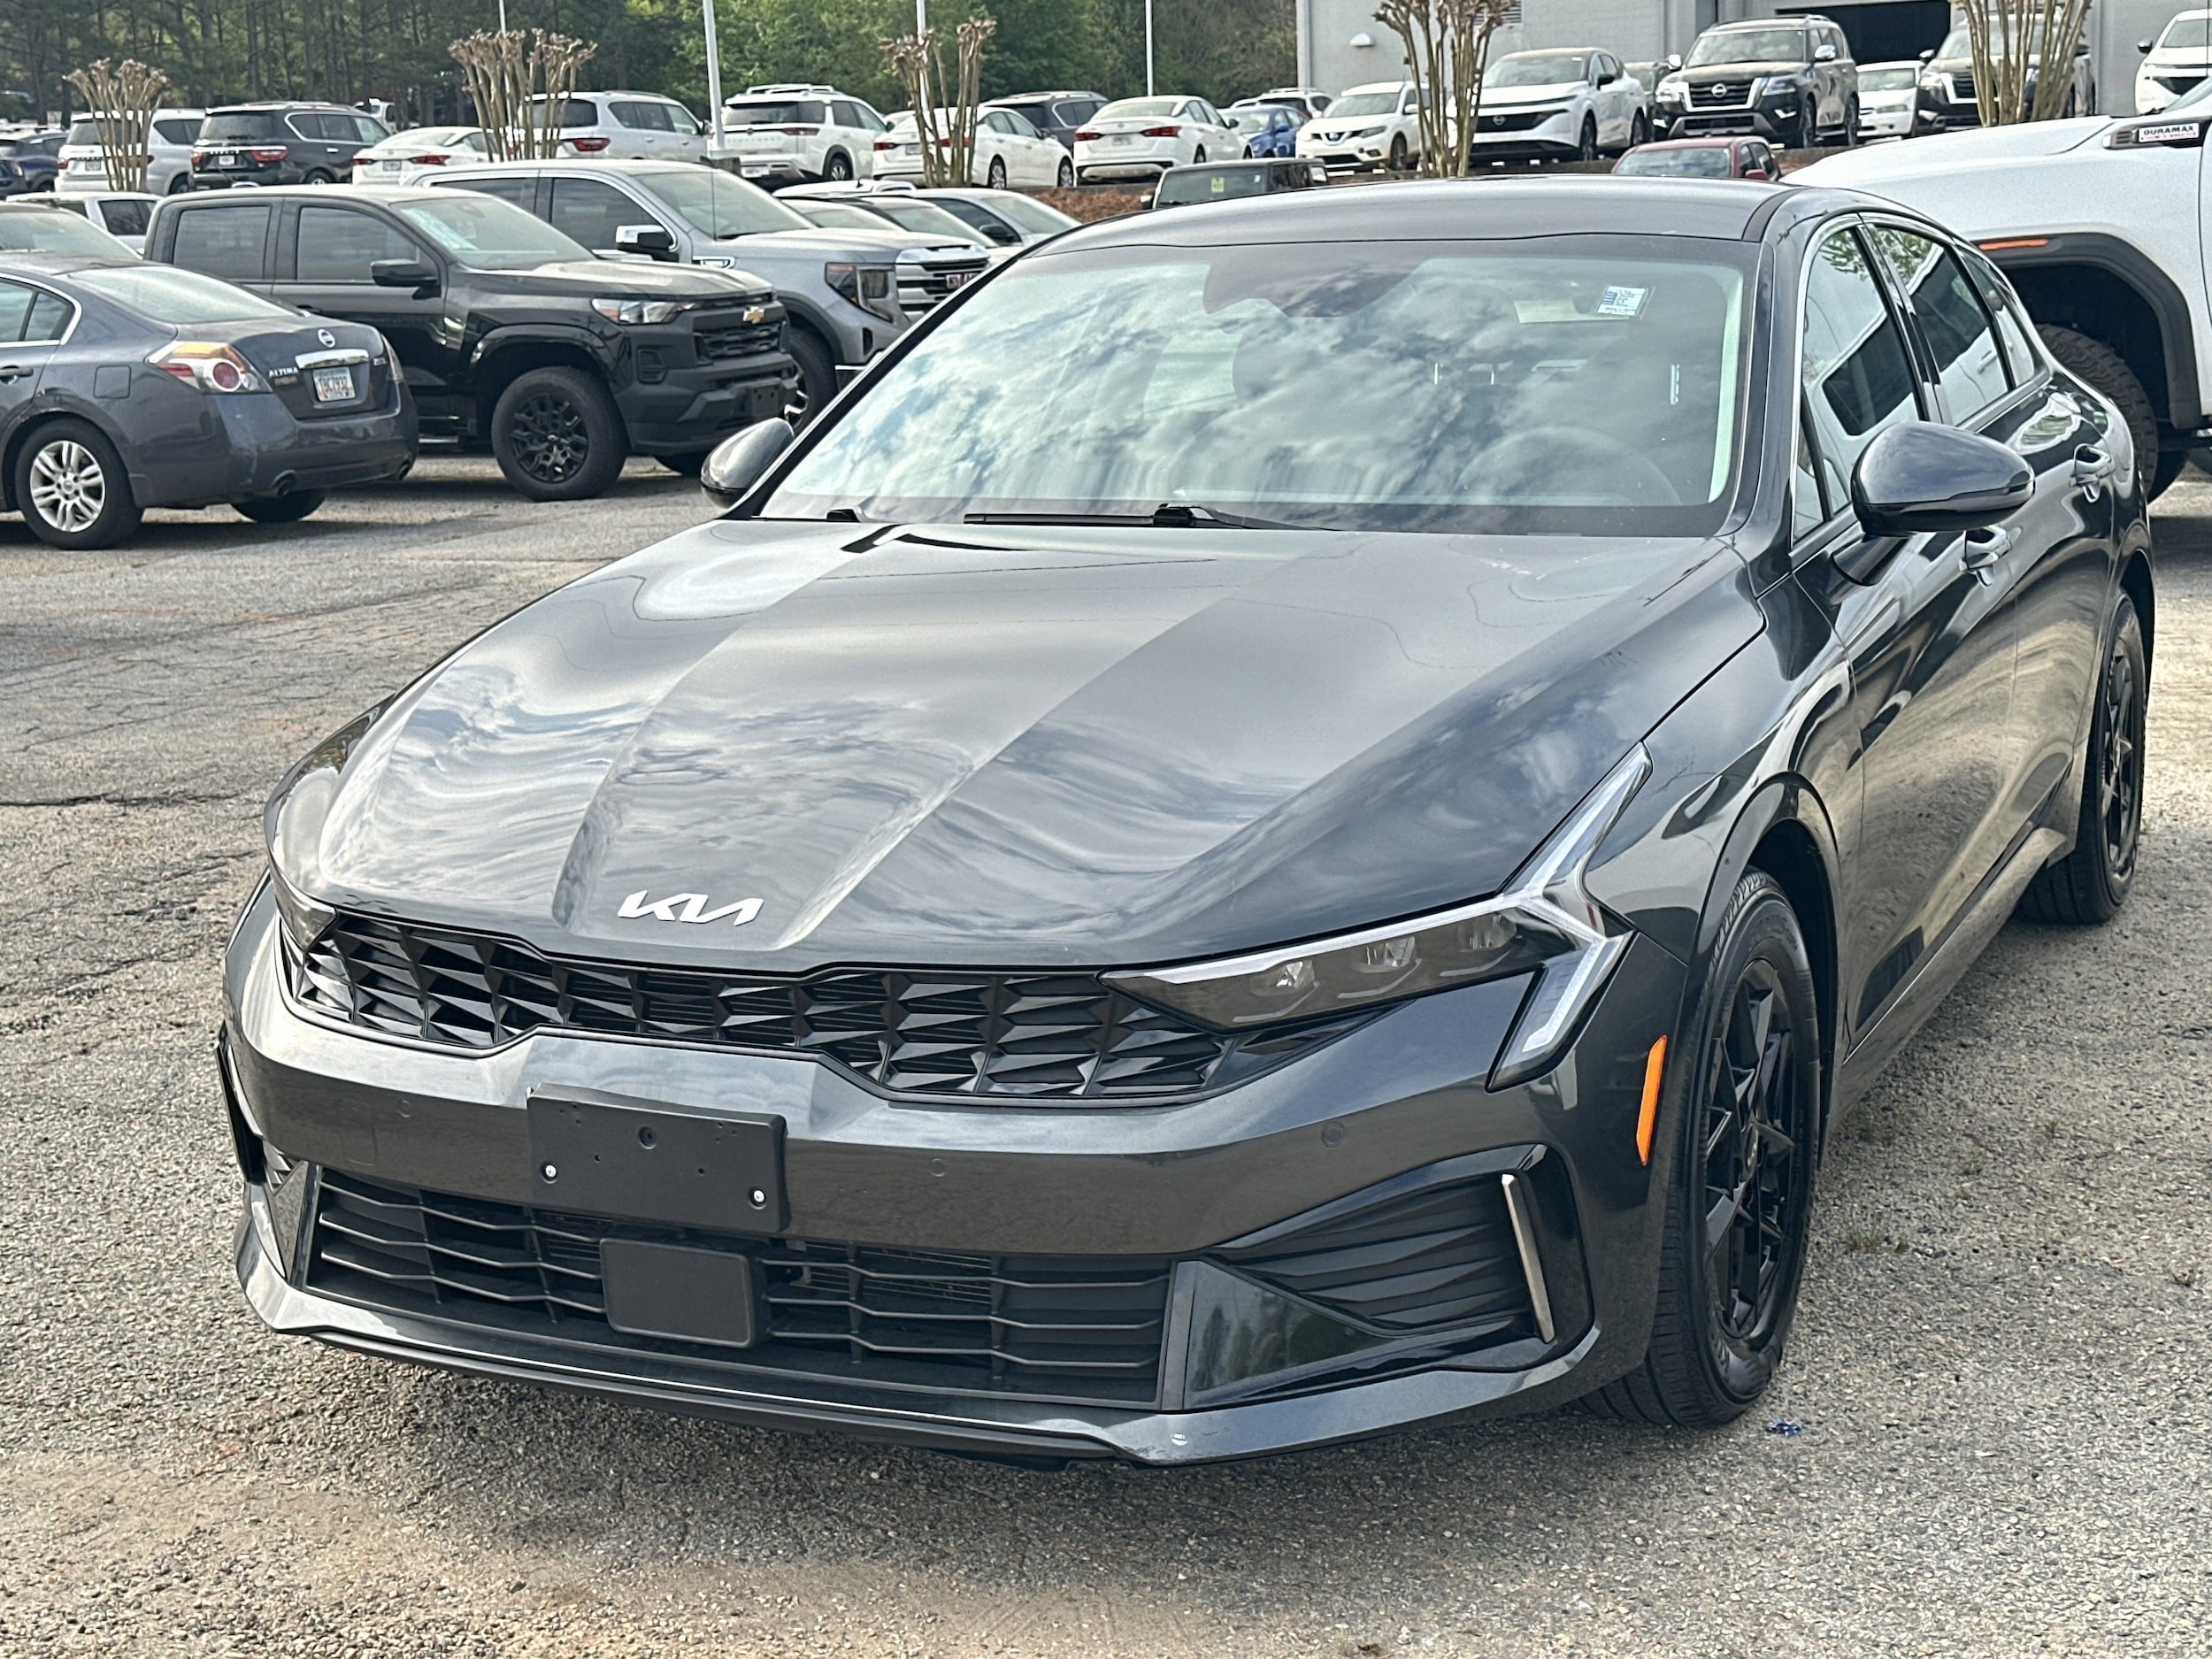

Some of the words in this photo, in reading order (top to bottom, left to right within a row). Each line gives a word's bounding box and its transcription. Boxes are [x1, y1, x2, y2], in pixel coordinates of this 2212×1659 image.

[2143, 126, 2194, 136] DURAMAX
[269, 366, 299, 378] ALTIMA
[618, 889, 764, 926] KIA
